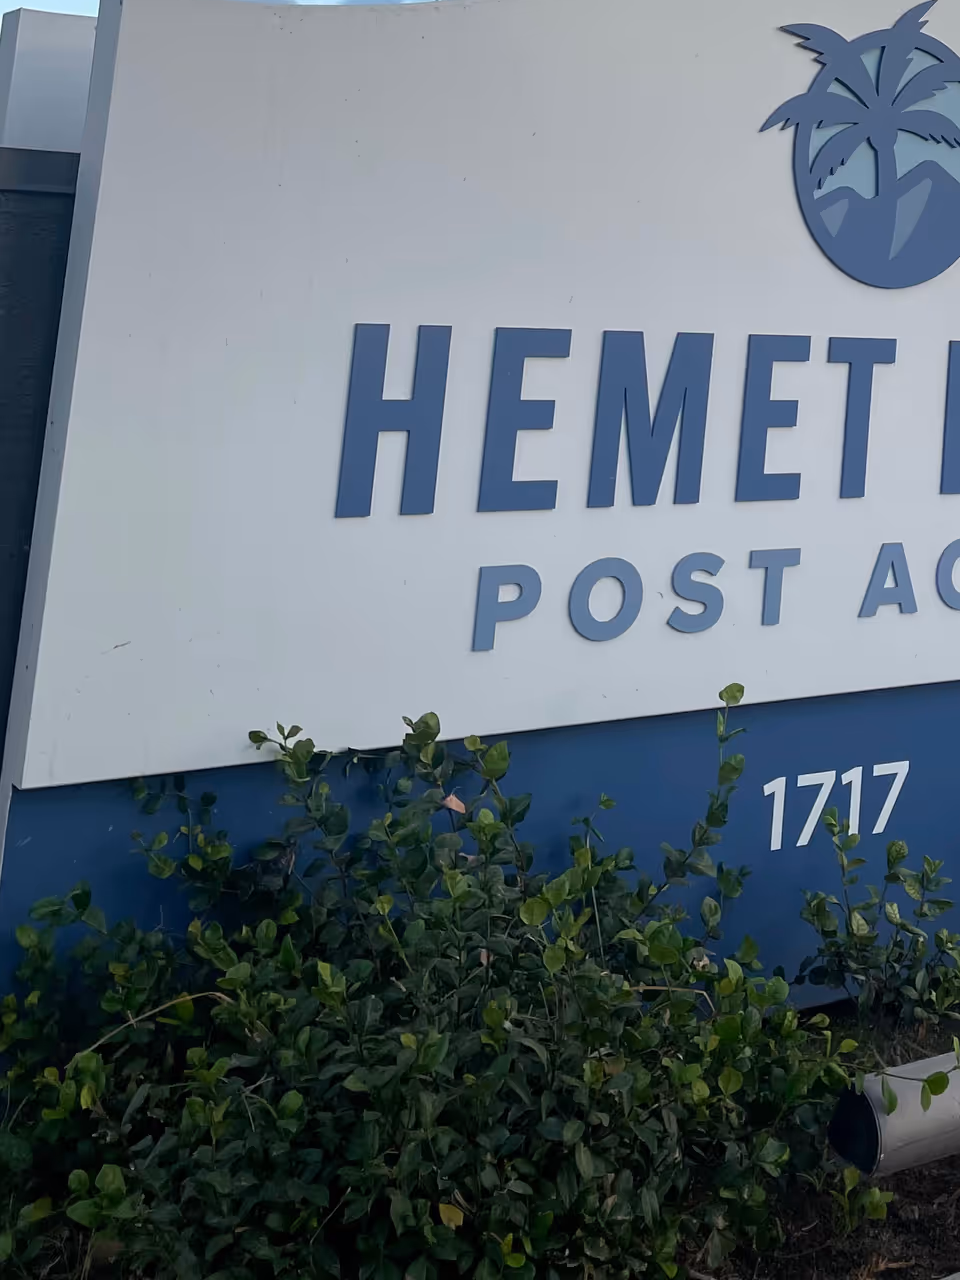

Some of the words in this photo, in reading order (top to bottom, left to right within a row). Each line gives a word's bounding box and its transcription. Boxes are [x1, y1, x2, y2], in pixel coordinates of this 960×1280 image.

[334, 322, 897, 518] HEMET
[471, 545, 801, 652] POST
[762, 760, 910, 851] 1717
